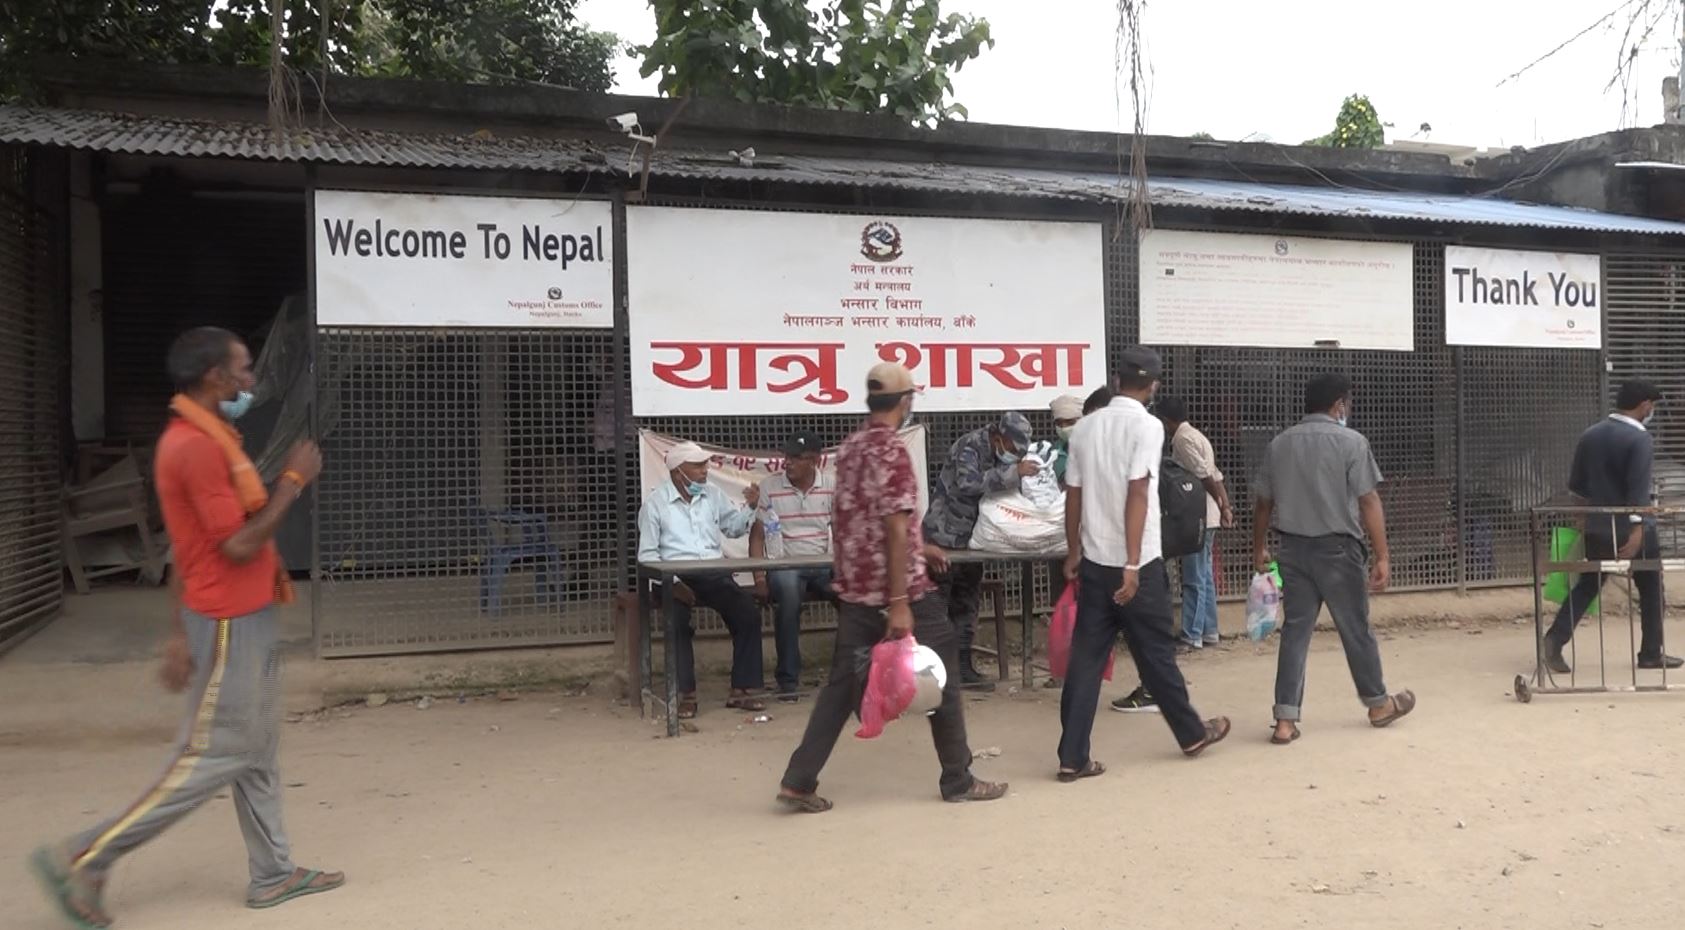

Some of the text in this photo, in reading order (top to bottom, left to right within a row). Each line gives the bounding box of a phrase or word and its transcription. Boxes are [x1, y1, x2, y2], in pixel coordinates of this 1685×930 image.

[323, 218, 604, 271] Welcome To Nepal
[850, 263, 914, 277] नेपाल सरकार
[1451, 267, 1597, 308] Thank You
[508, 300, 603, 310] Nepalgunj Customs Office
[840, 298, 879, 310] भन्सार
[783, 313, 845, 328] नेपालगञ्ज
[851, 315, 890, 328] भन्सार
[650, 341, 1091, 405] यात्रु शाखा
